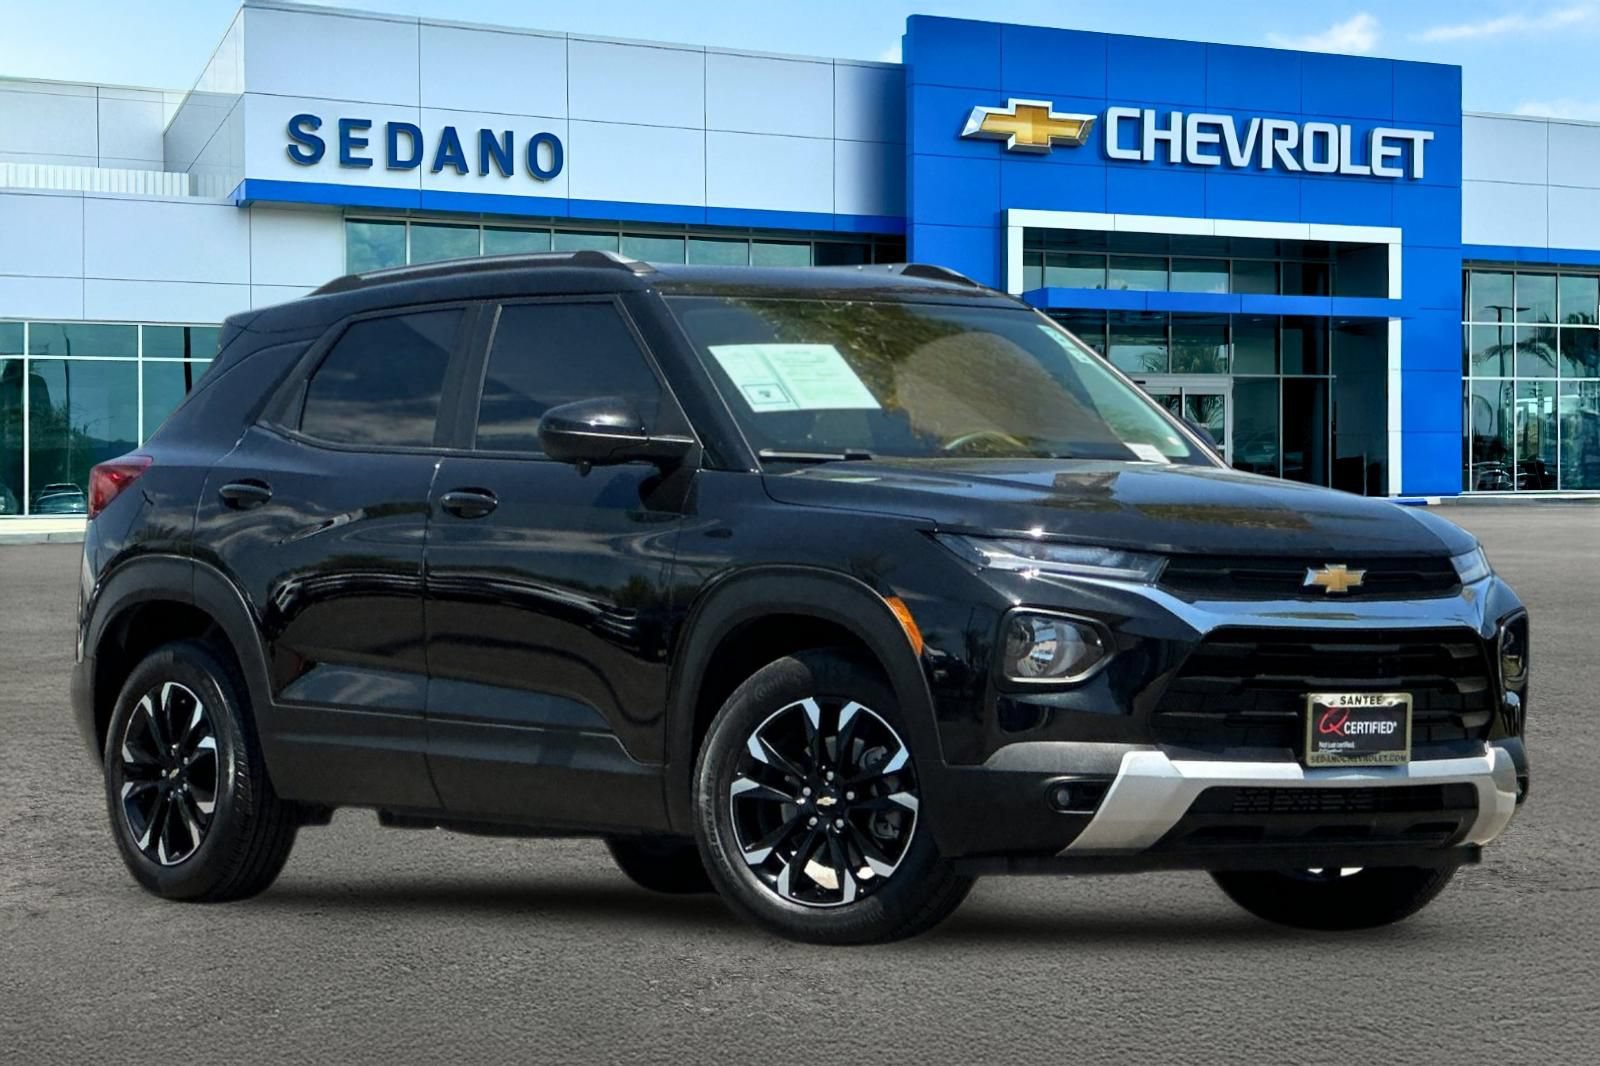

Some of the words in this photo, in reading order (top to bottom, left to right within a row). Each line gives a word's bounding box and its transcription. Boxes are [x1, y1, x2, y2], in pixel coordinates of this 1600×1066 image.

[286, 113, 564, 182] SEDANO
[1105, 106, 1435, 179] CHEVROLET
[1340, 695, 1383, 705] SANTEE
